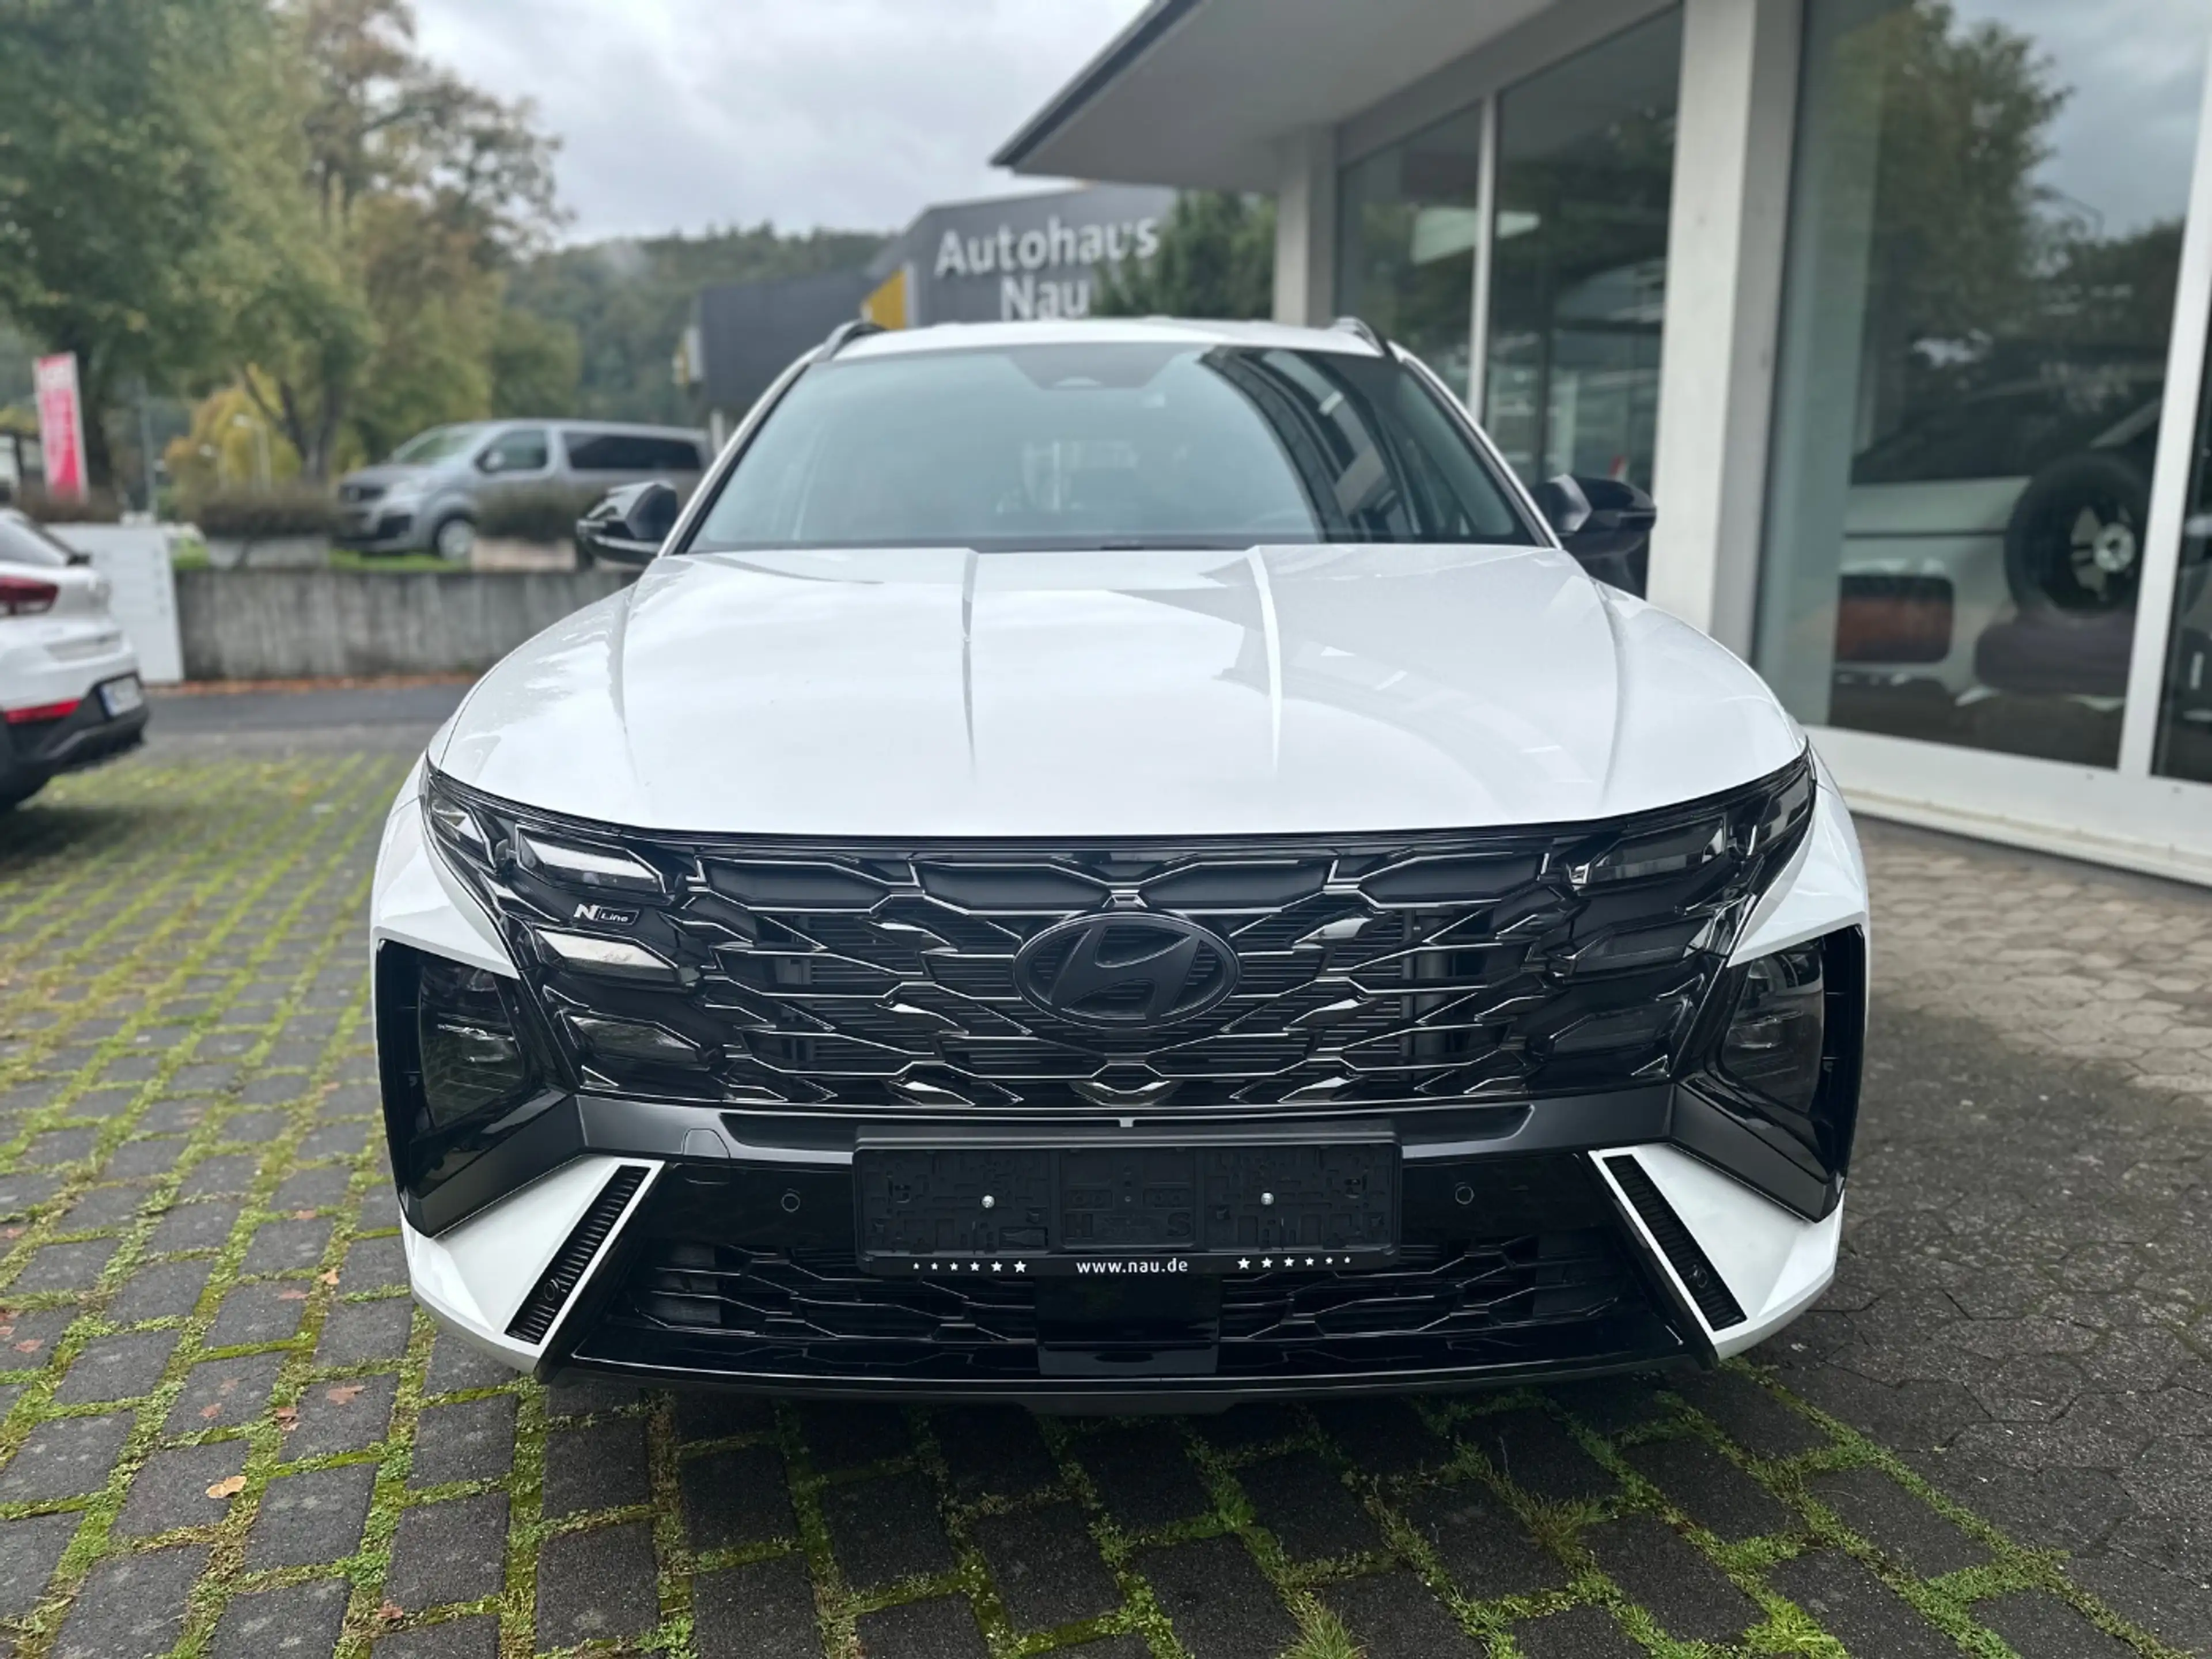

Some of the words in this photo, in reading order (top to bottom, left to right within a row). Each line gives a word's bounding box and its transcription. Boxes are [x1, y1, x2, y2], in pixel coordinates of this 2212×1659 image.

[933, 215, 1160, 277] Autohaus
[1001, 274, 1090, 321] Nau
[574, 903, 601, 921] N
[601, 912, 628, 922] Line
[1075, 1257, 1188, 1274] www.nau.de
